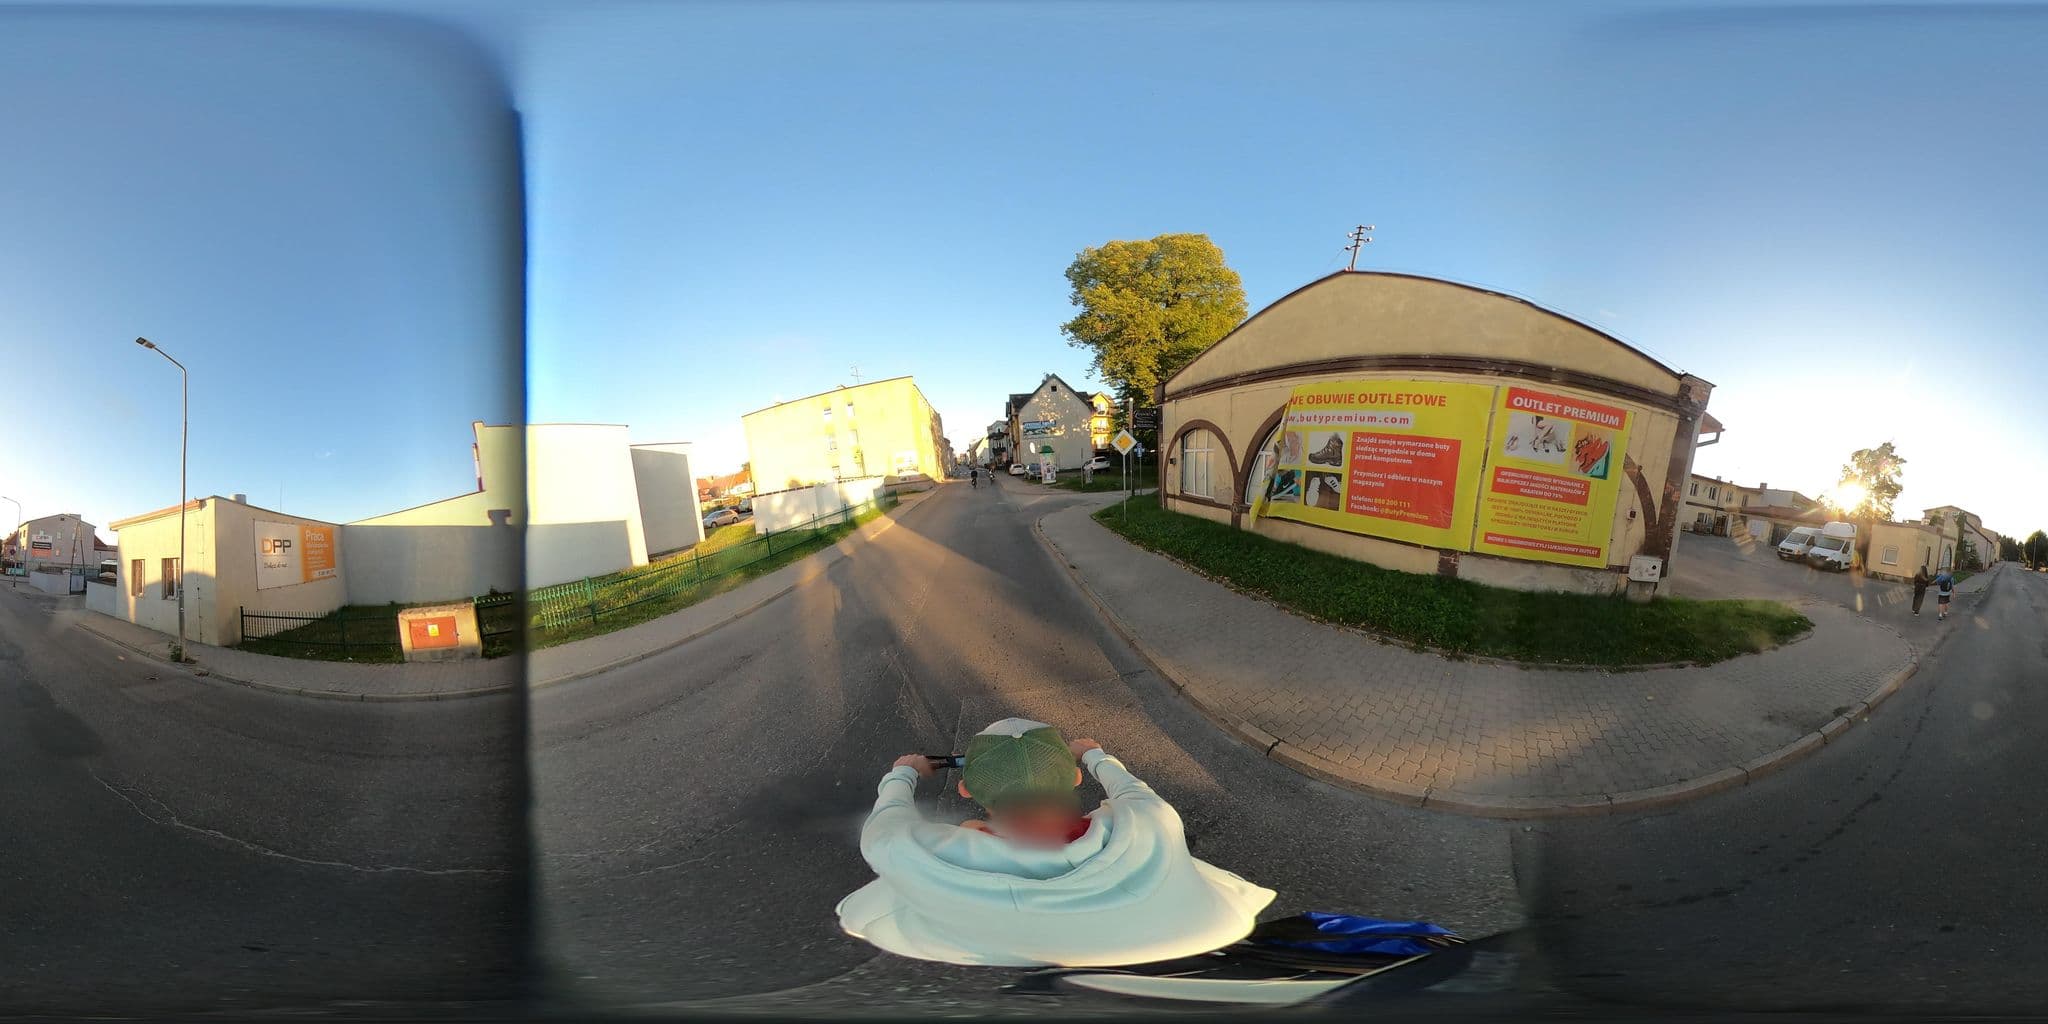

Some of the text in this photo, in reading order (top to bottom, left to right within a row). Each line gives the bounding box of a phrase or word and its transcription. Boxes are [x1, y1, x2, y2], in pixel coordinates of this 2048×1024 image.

[1307, 394, 1355, 405] OBUWIE
[1358, 393, 1446, 407] OUTLETOWE
[1513, 396, 1618, 426] OUTLET PREMIUM
[1435, 443, 1450, 451] buty
[1373, 455, 1412, 464] komputerem
[1419, 478, 1443, 486] naszym
[262, 539, 291, 553] DPP
